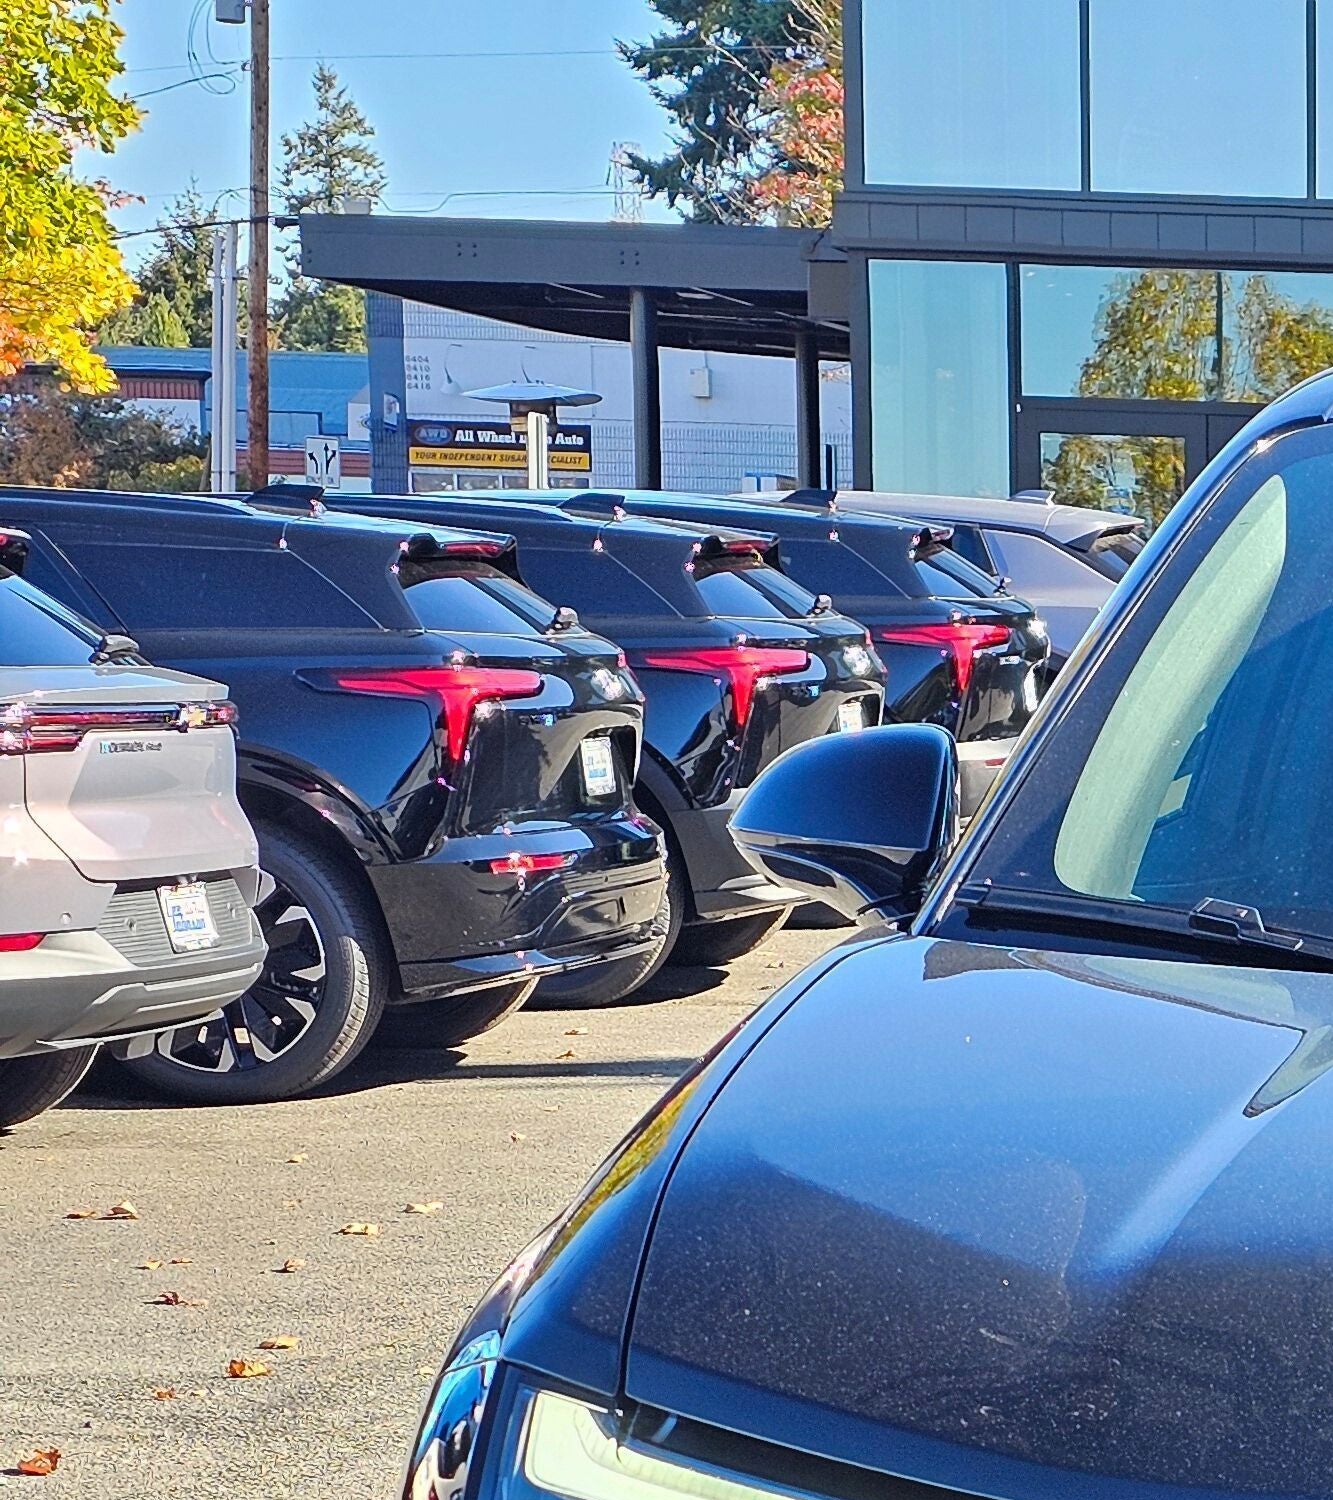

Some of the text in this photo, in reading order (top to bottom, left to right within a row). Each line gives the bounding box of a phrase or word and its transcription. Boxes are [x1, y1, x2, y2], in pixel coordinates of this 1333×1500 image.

[455, 430, 474, 442] All
[477, 430, 516, 443] Wheel
[555, 433, 584, 445] Auto
[415, 451, 437, 459] YOUR
[440, 453, 497, 461] INDEPENDENT
[499, 454, 527, 463] SUBAR
